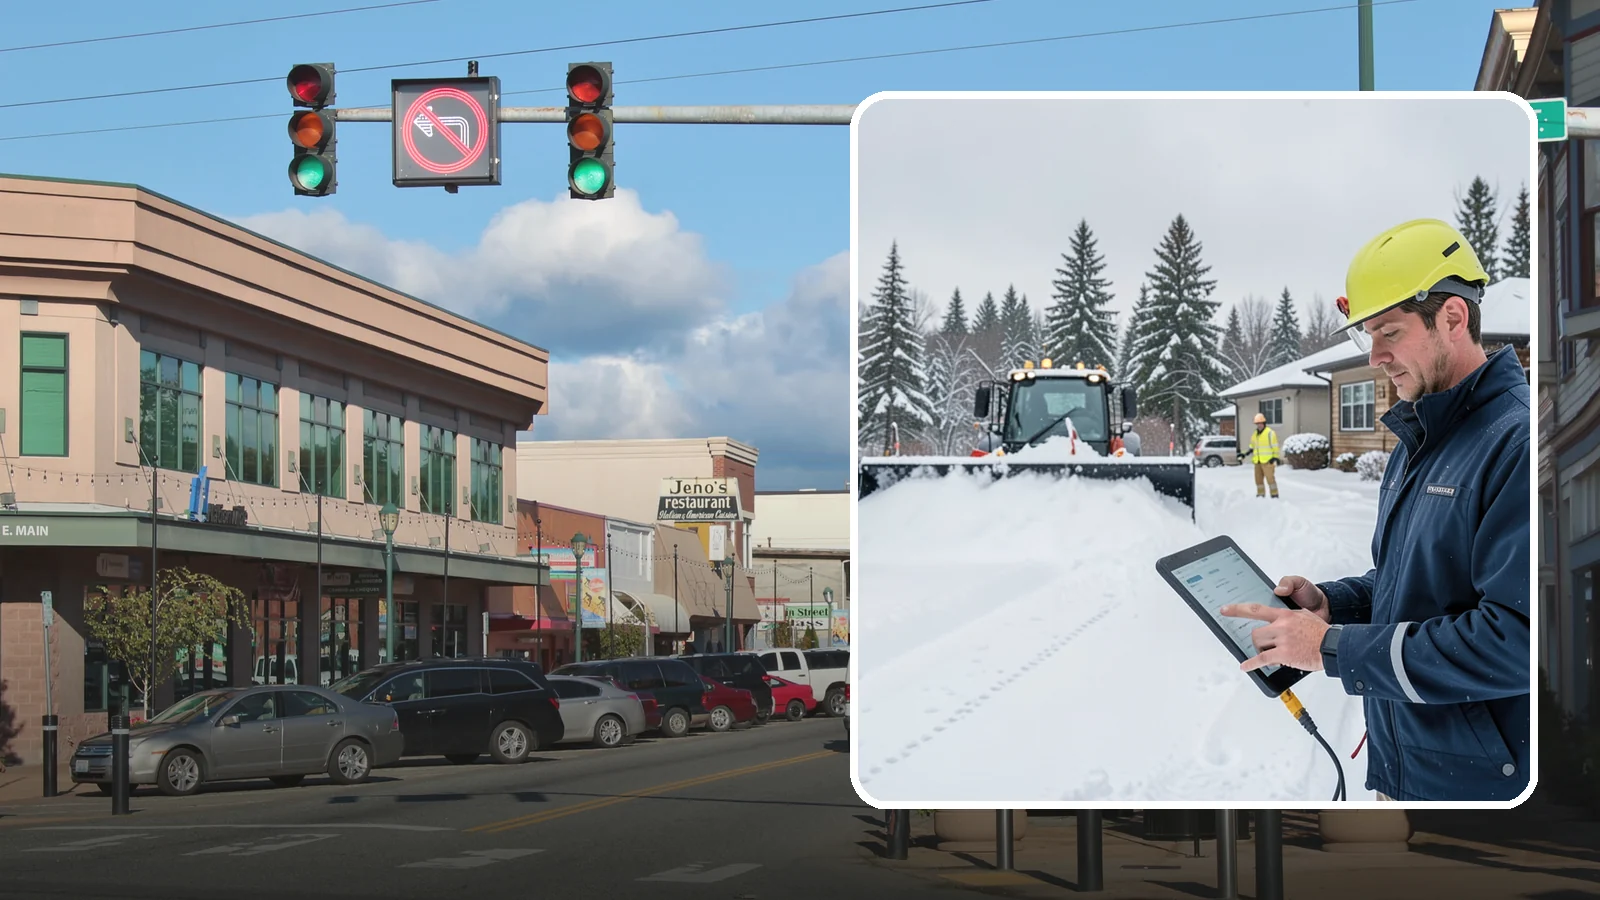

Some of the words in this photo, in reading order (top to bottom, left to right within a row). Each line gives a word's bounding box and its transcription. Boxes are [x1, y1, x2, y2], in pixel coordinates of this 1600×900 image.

[670, 480, 727, 494] Jeno's
[665, 497, 731, 509] restaurant
[658, 510, 681, 519] Italian
[686, 509, 714, 519] American
[715, 509, 738, 519] Cuisine
[2, 525, 13, 536] E.
[15, 525, 49, 536] MAIN
[797, 607, 829, 617] Street
[789, 619, 823, 627] lass
